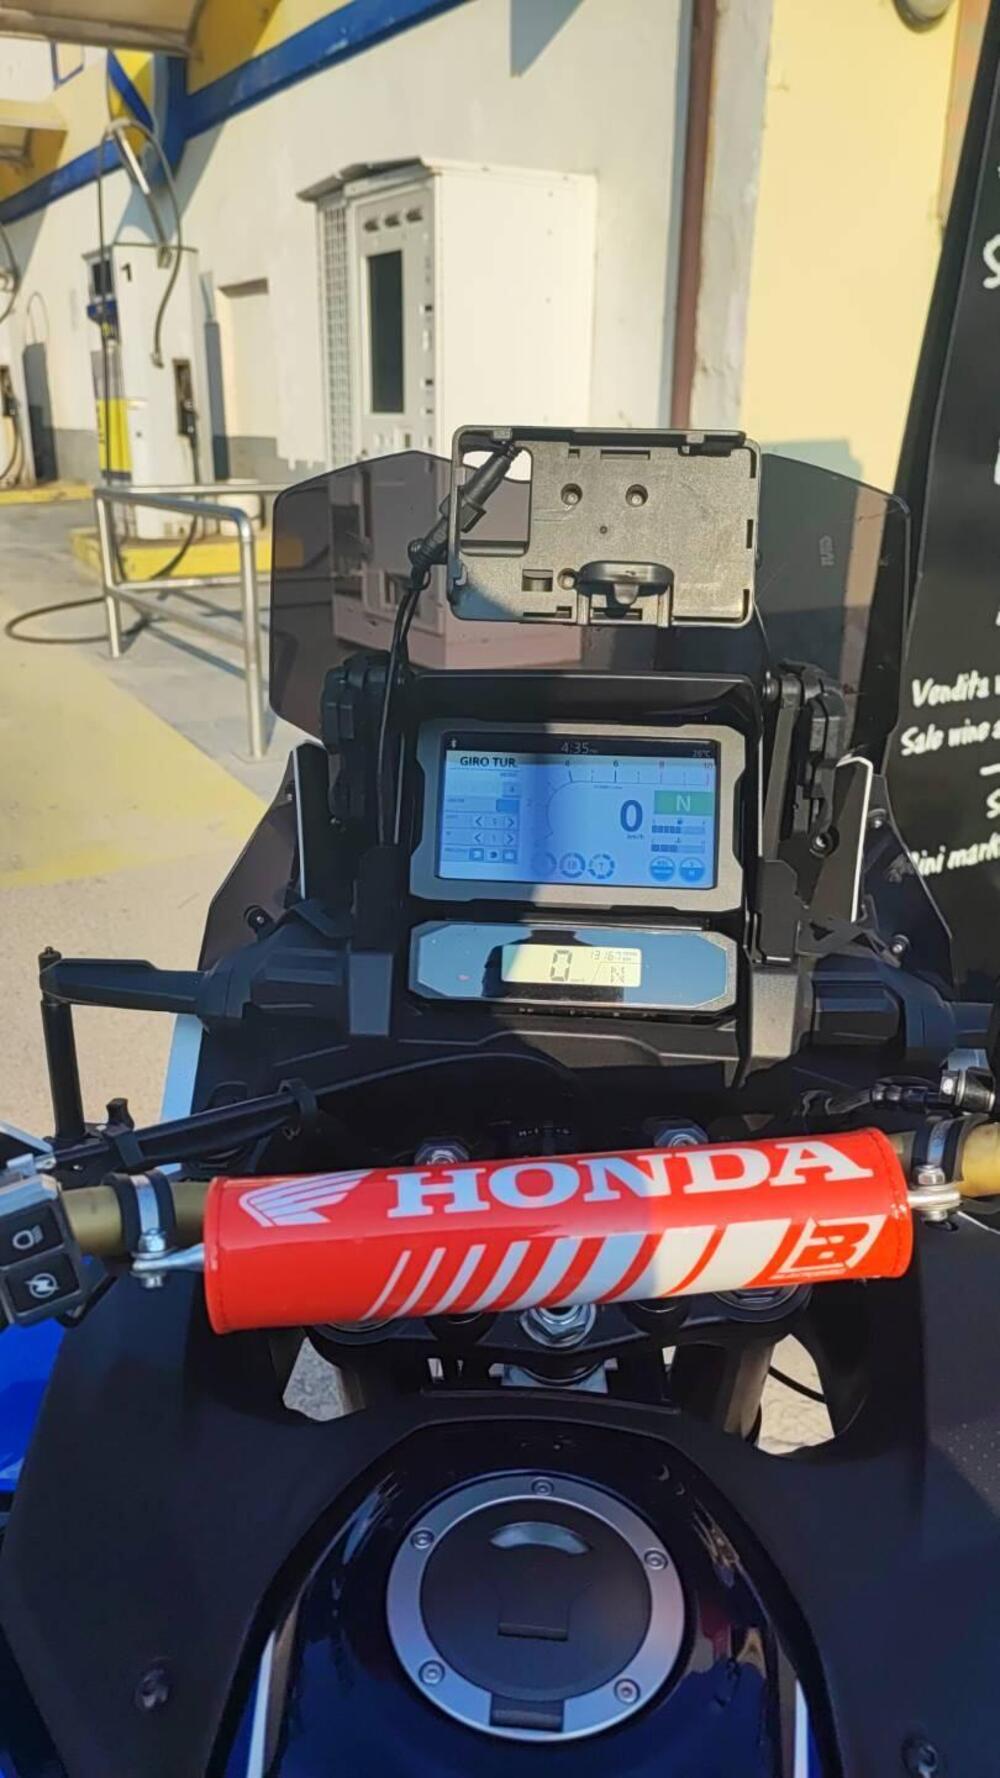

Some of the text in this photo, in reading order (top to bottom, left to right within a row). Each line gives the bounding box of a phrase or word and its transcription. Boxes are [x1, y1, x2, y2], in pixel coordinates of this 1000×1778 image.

[121, 263, 132, 282] 1
[912, 669, 990, 708] Vendita
[561, 742, 589, 754] 4:35
[901, 723, 945, 756] Sale
[460, 756, 490, 767] GIRO
[620, 800, 643, 832] 0
[676, 794, 691, 812] N
[549, 949, 573, 982] 0
[388, 1141, 873, 1218] HONDA
